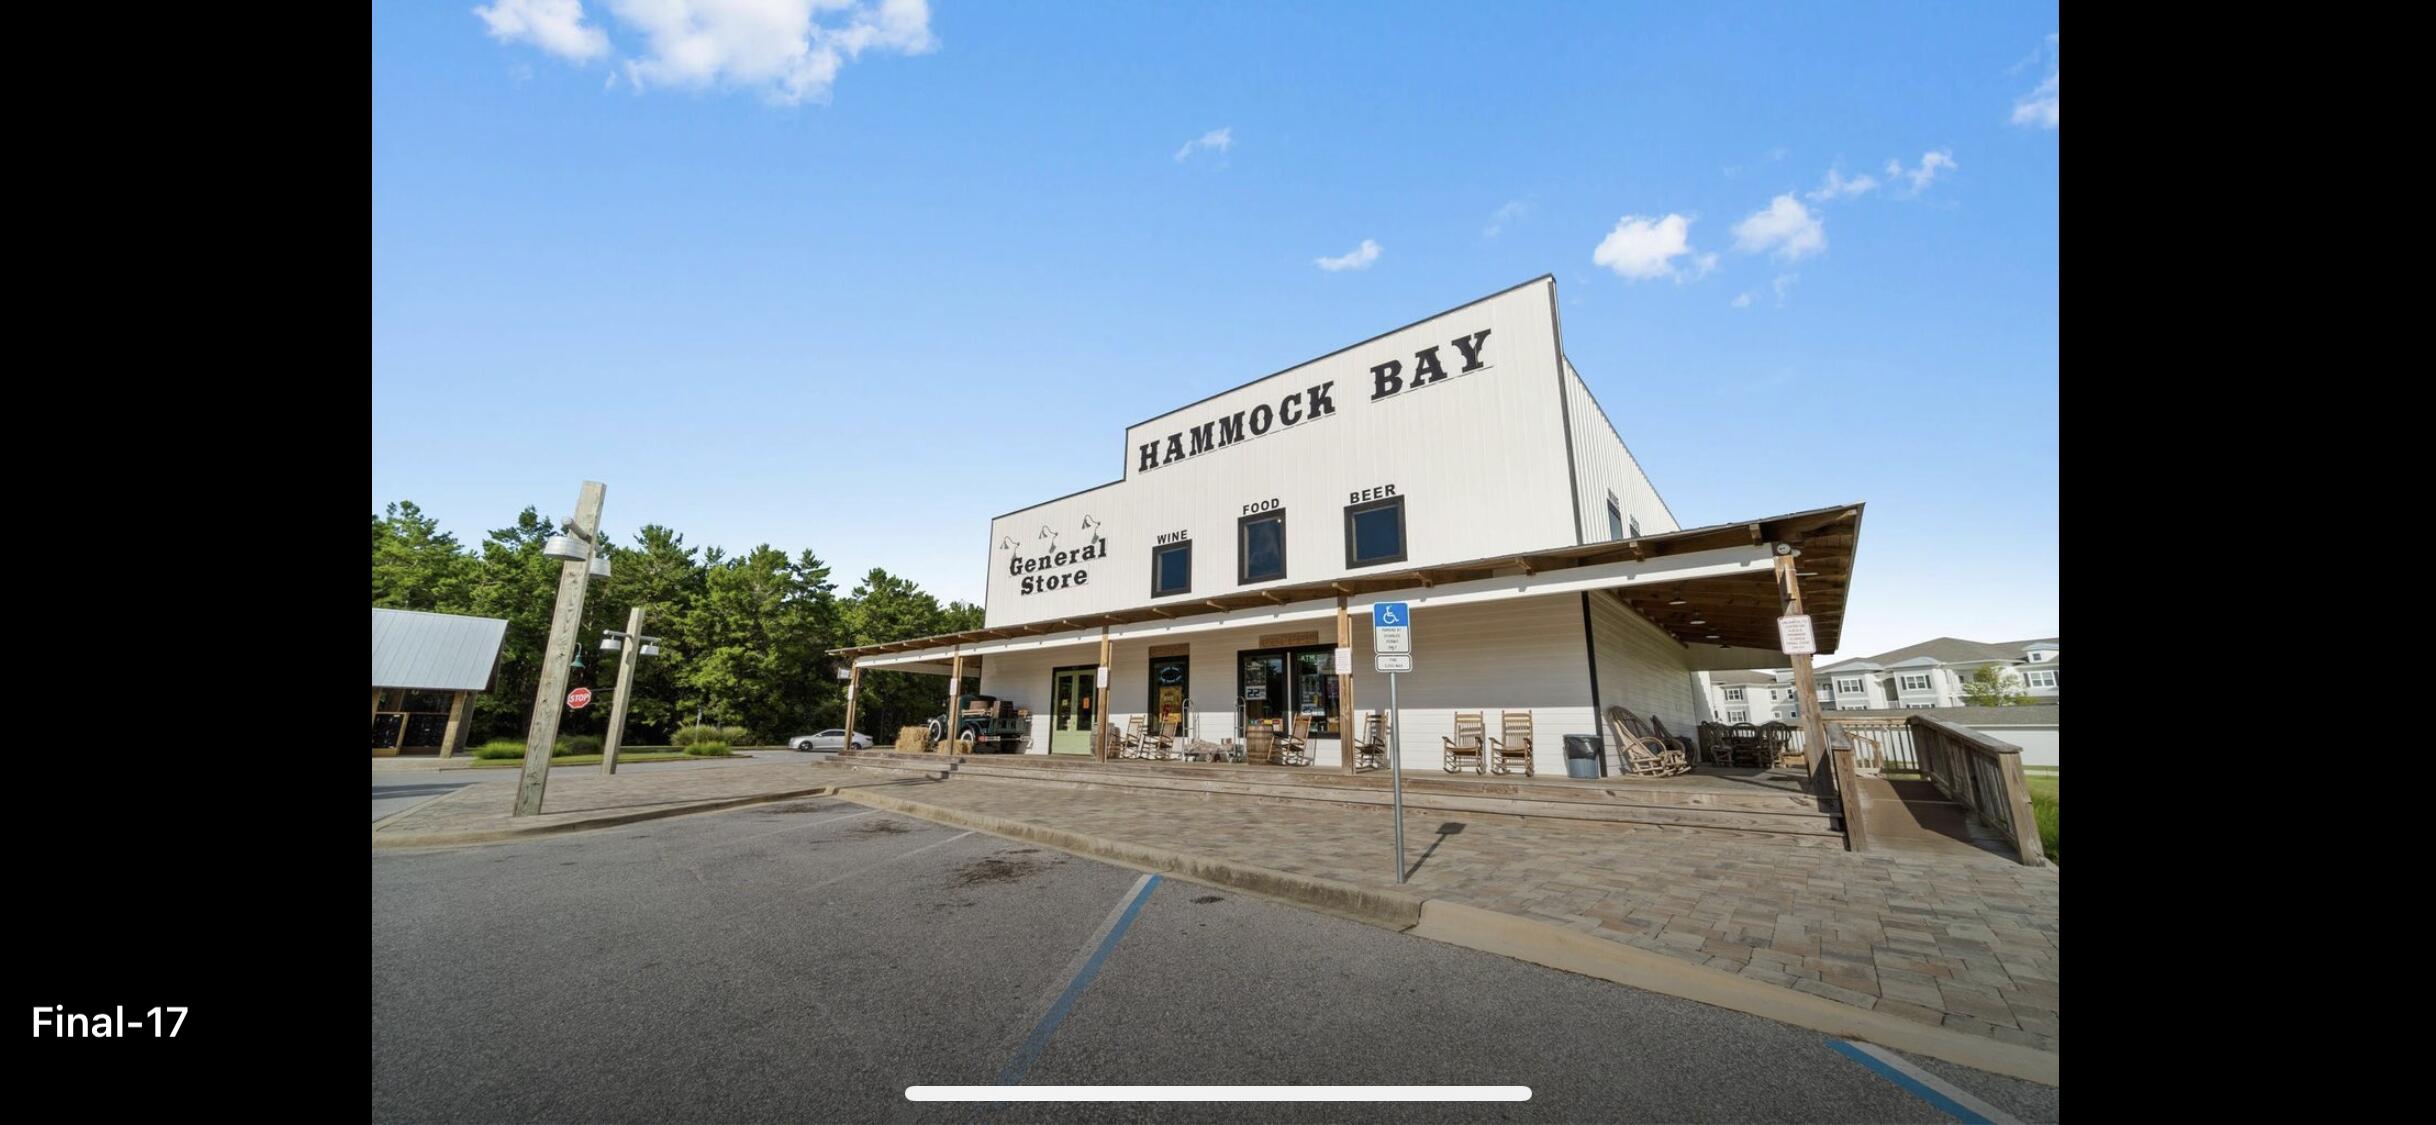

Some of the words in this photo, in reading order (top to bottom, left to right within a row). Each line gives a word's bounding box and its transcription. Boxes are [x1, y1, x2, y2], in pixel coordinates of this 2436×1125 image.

[1138, 380, 1336, 473] HAMMOCK
[1370, 328, 1492, 402] BAY
[1350, 483, 1396, 504] BEER
[1242, 498, 1280, 515] FOOD
[1157, 530, 1188, 545] WINE
[1010, 538, 1107, 577] General
[1020, 568, 1088, 596] Store
[570, 693, 589, 702] STOP
